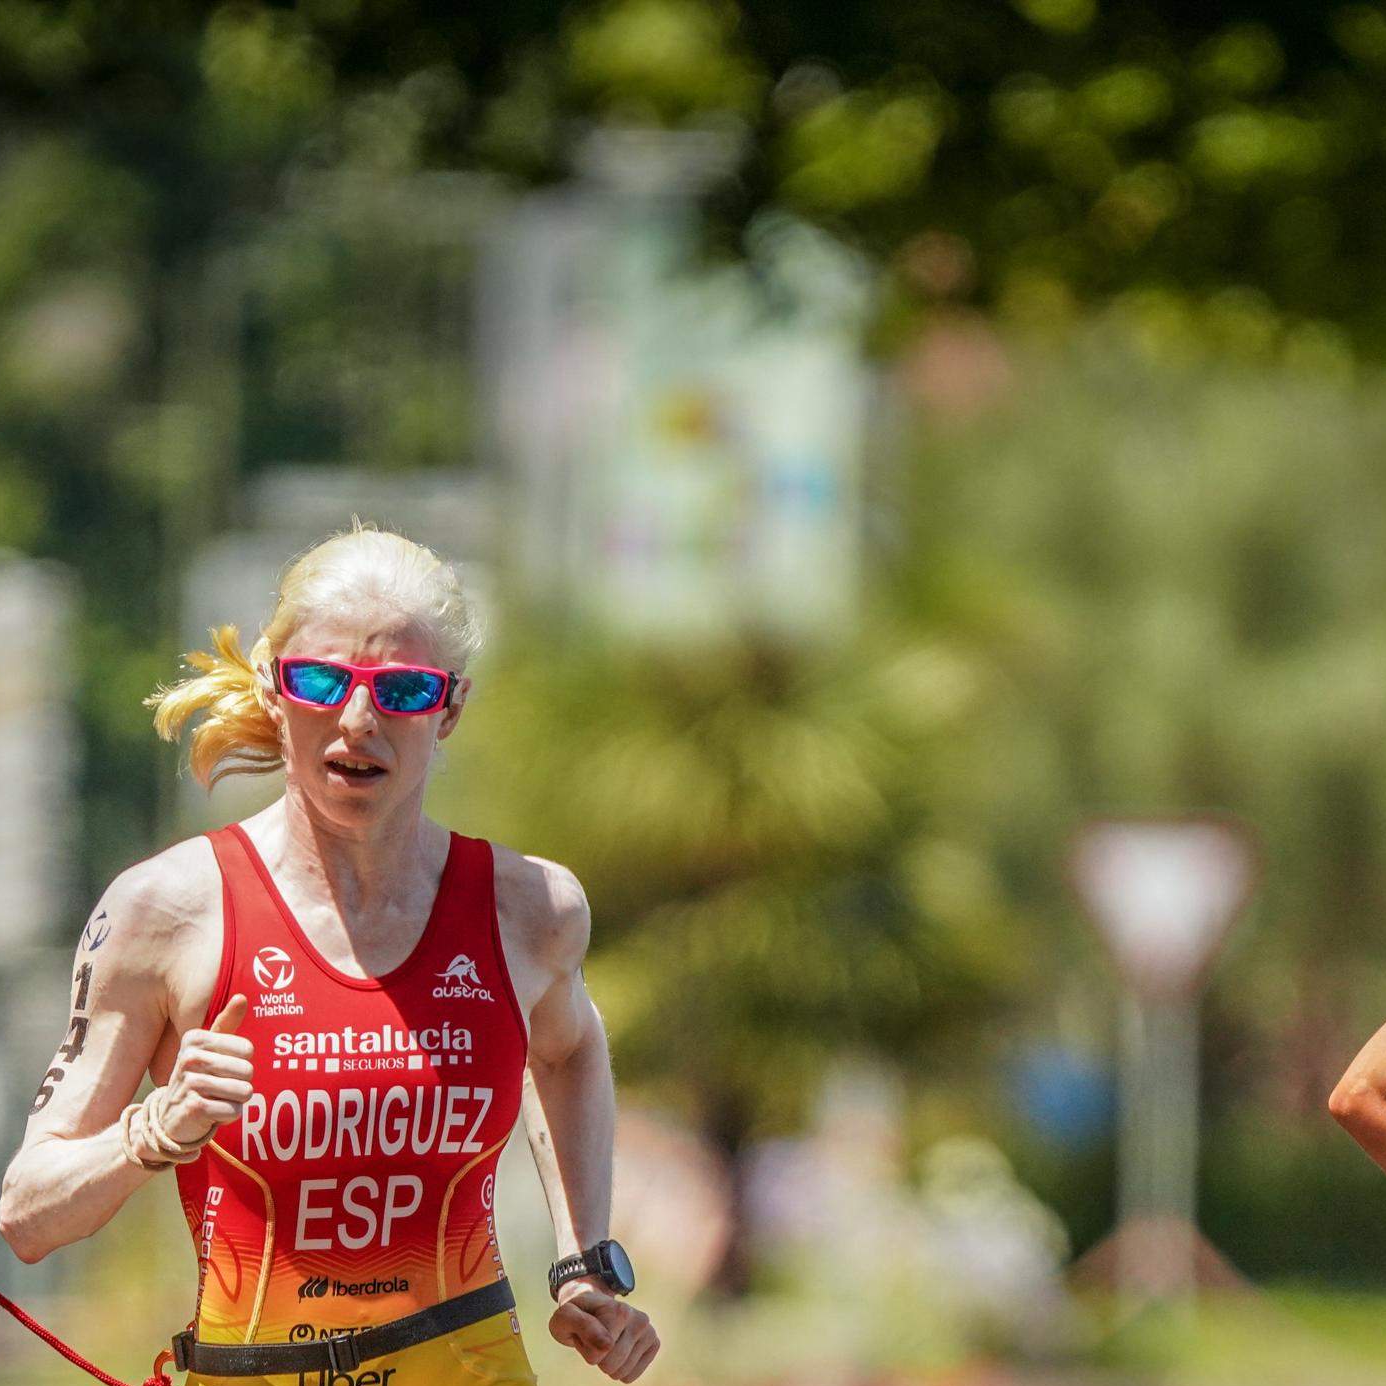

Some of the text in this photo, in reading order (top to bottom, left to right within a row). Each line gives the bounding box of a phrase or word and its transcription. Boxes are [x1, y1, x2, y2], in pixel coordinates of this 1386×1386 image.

[260, 992, 294, 1004] World
[433, 986, 495, 1002] austral
[253, 1003, 304, 1018] Triathlon
[29, 962, 93, 1115] 146
[274, 1021, 472, 1056] santalucía
[343, 1058, 405, 1071] SEGUROS
[241, 1085, 493, 1162] RODRIGUEZ
[294, 1174, 424, 1250] ESP
[332, 1276, 409, 1297] Iberdrola
